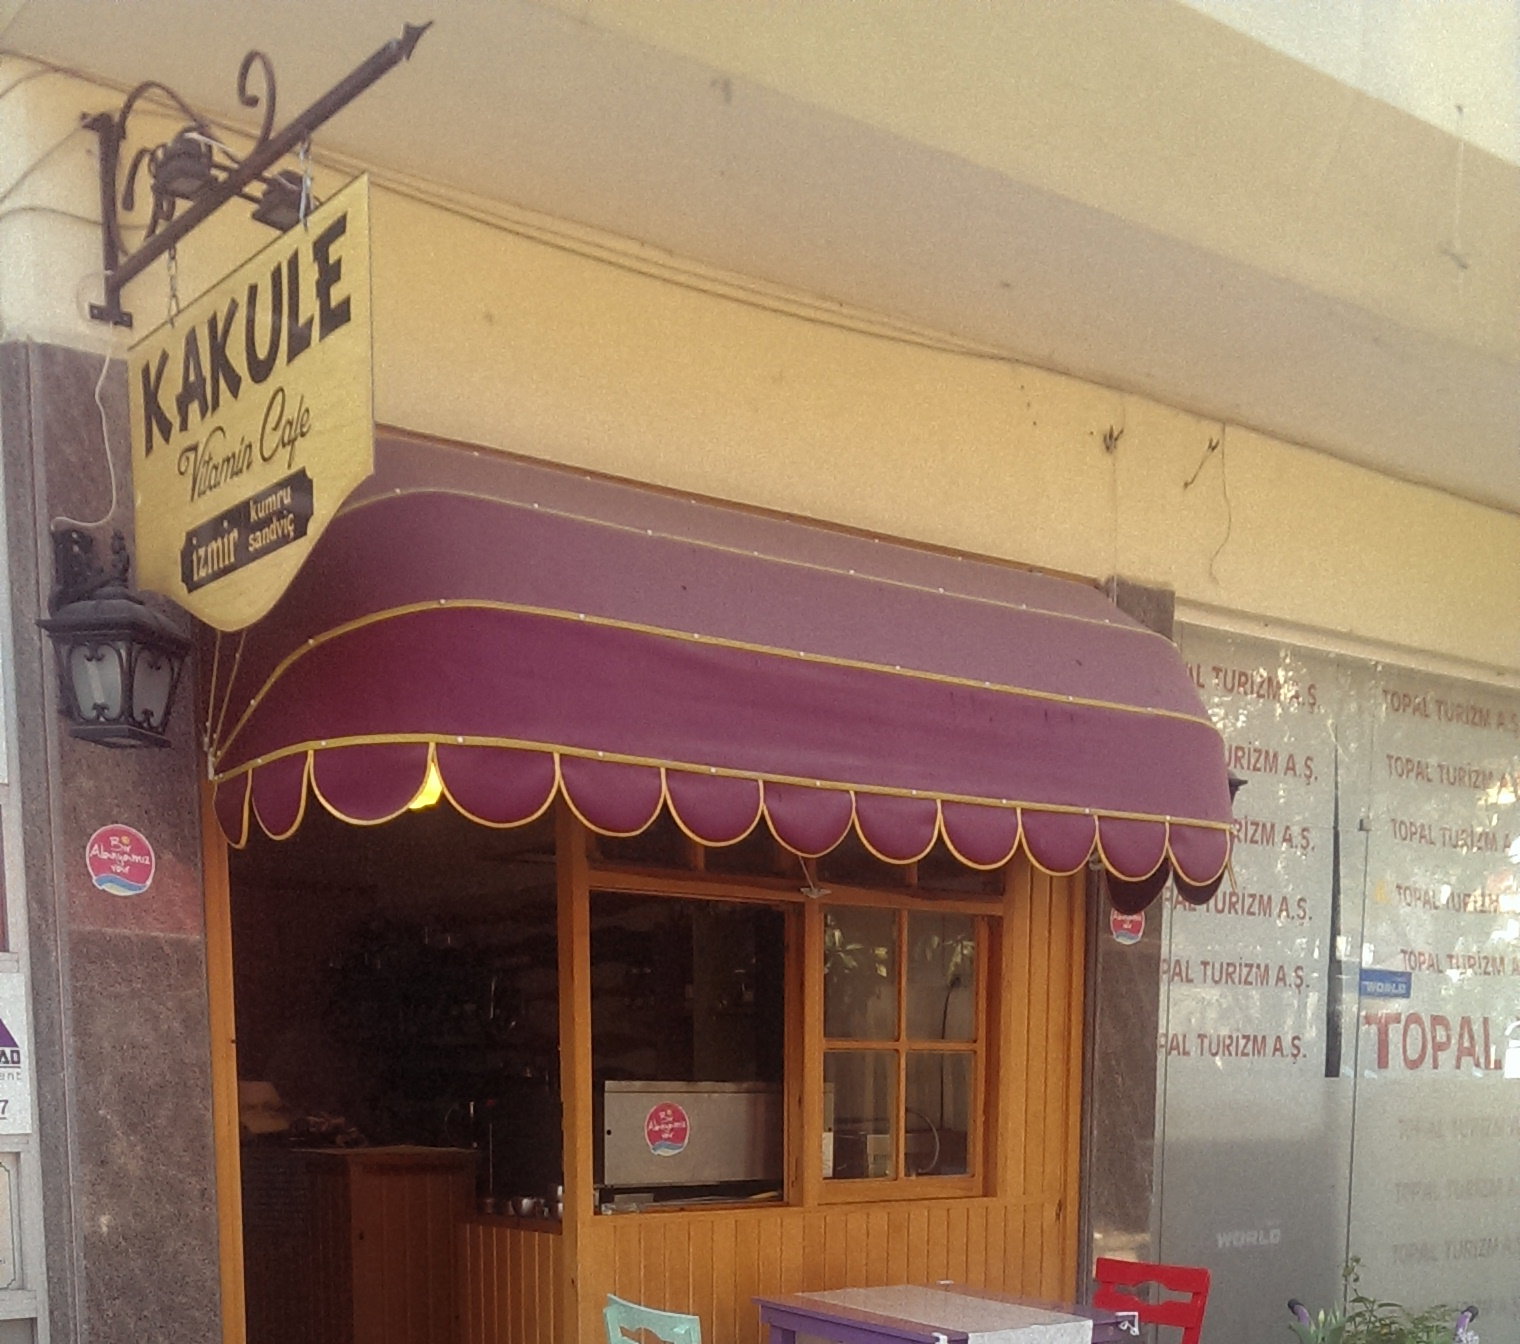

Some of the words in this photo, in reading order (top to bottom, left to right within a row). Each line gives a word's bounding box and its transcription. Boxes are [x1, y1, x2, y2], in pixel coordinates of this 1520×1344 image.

[142, 212, 352, 458] KAKULE
[178, 426, 253, 502] Vitamin
[260, 386, 311, 470] Cafe
[250, 486, 292, 523] kumru
[248, 510, 295, 552] sandviç
[192, 519, 239, 581] izmir
[1382, 689, 1430, 718] TOPAL
[1283, 753, 1318, 786] A.Ş.
[1386, 753, 1433, 783] TOPAL
[1233, 816, 1276, 847] RİZM
[1391, 818, 1435, 846] TOPAL
[1160, 958, 1194, 984] PAL
[1274, 964, 1310, 995] A.Ş.
[1401, 949, 1443, 974] TOPAL
[1157, 1032, 1191, 1057] PAL
[1363, 1012, 1503, 1070] TOPAL
[1216, 1229, 1280, 1249] WORLD
